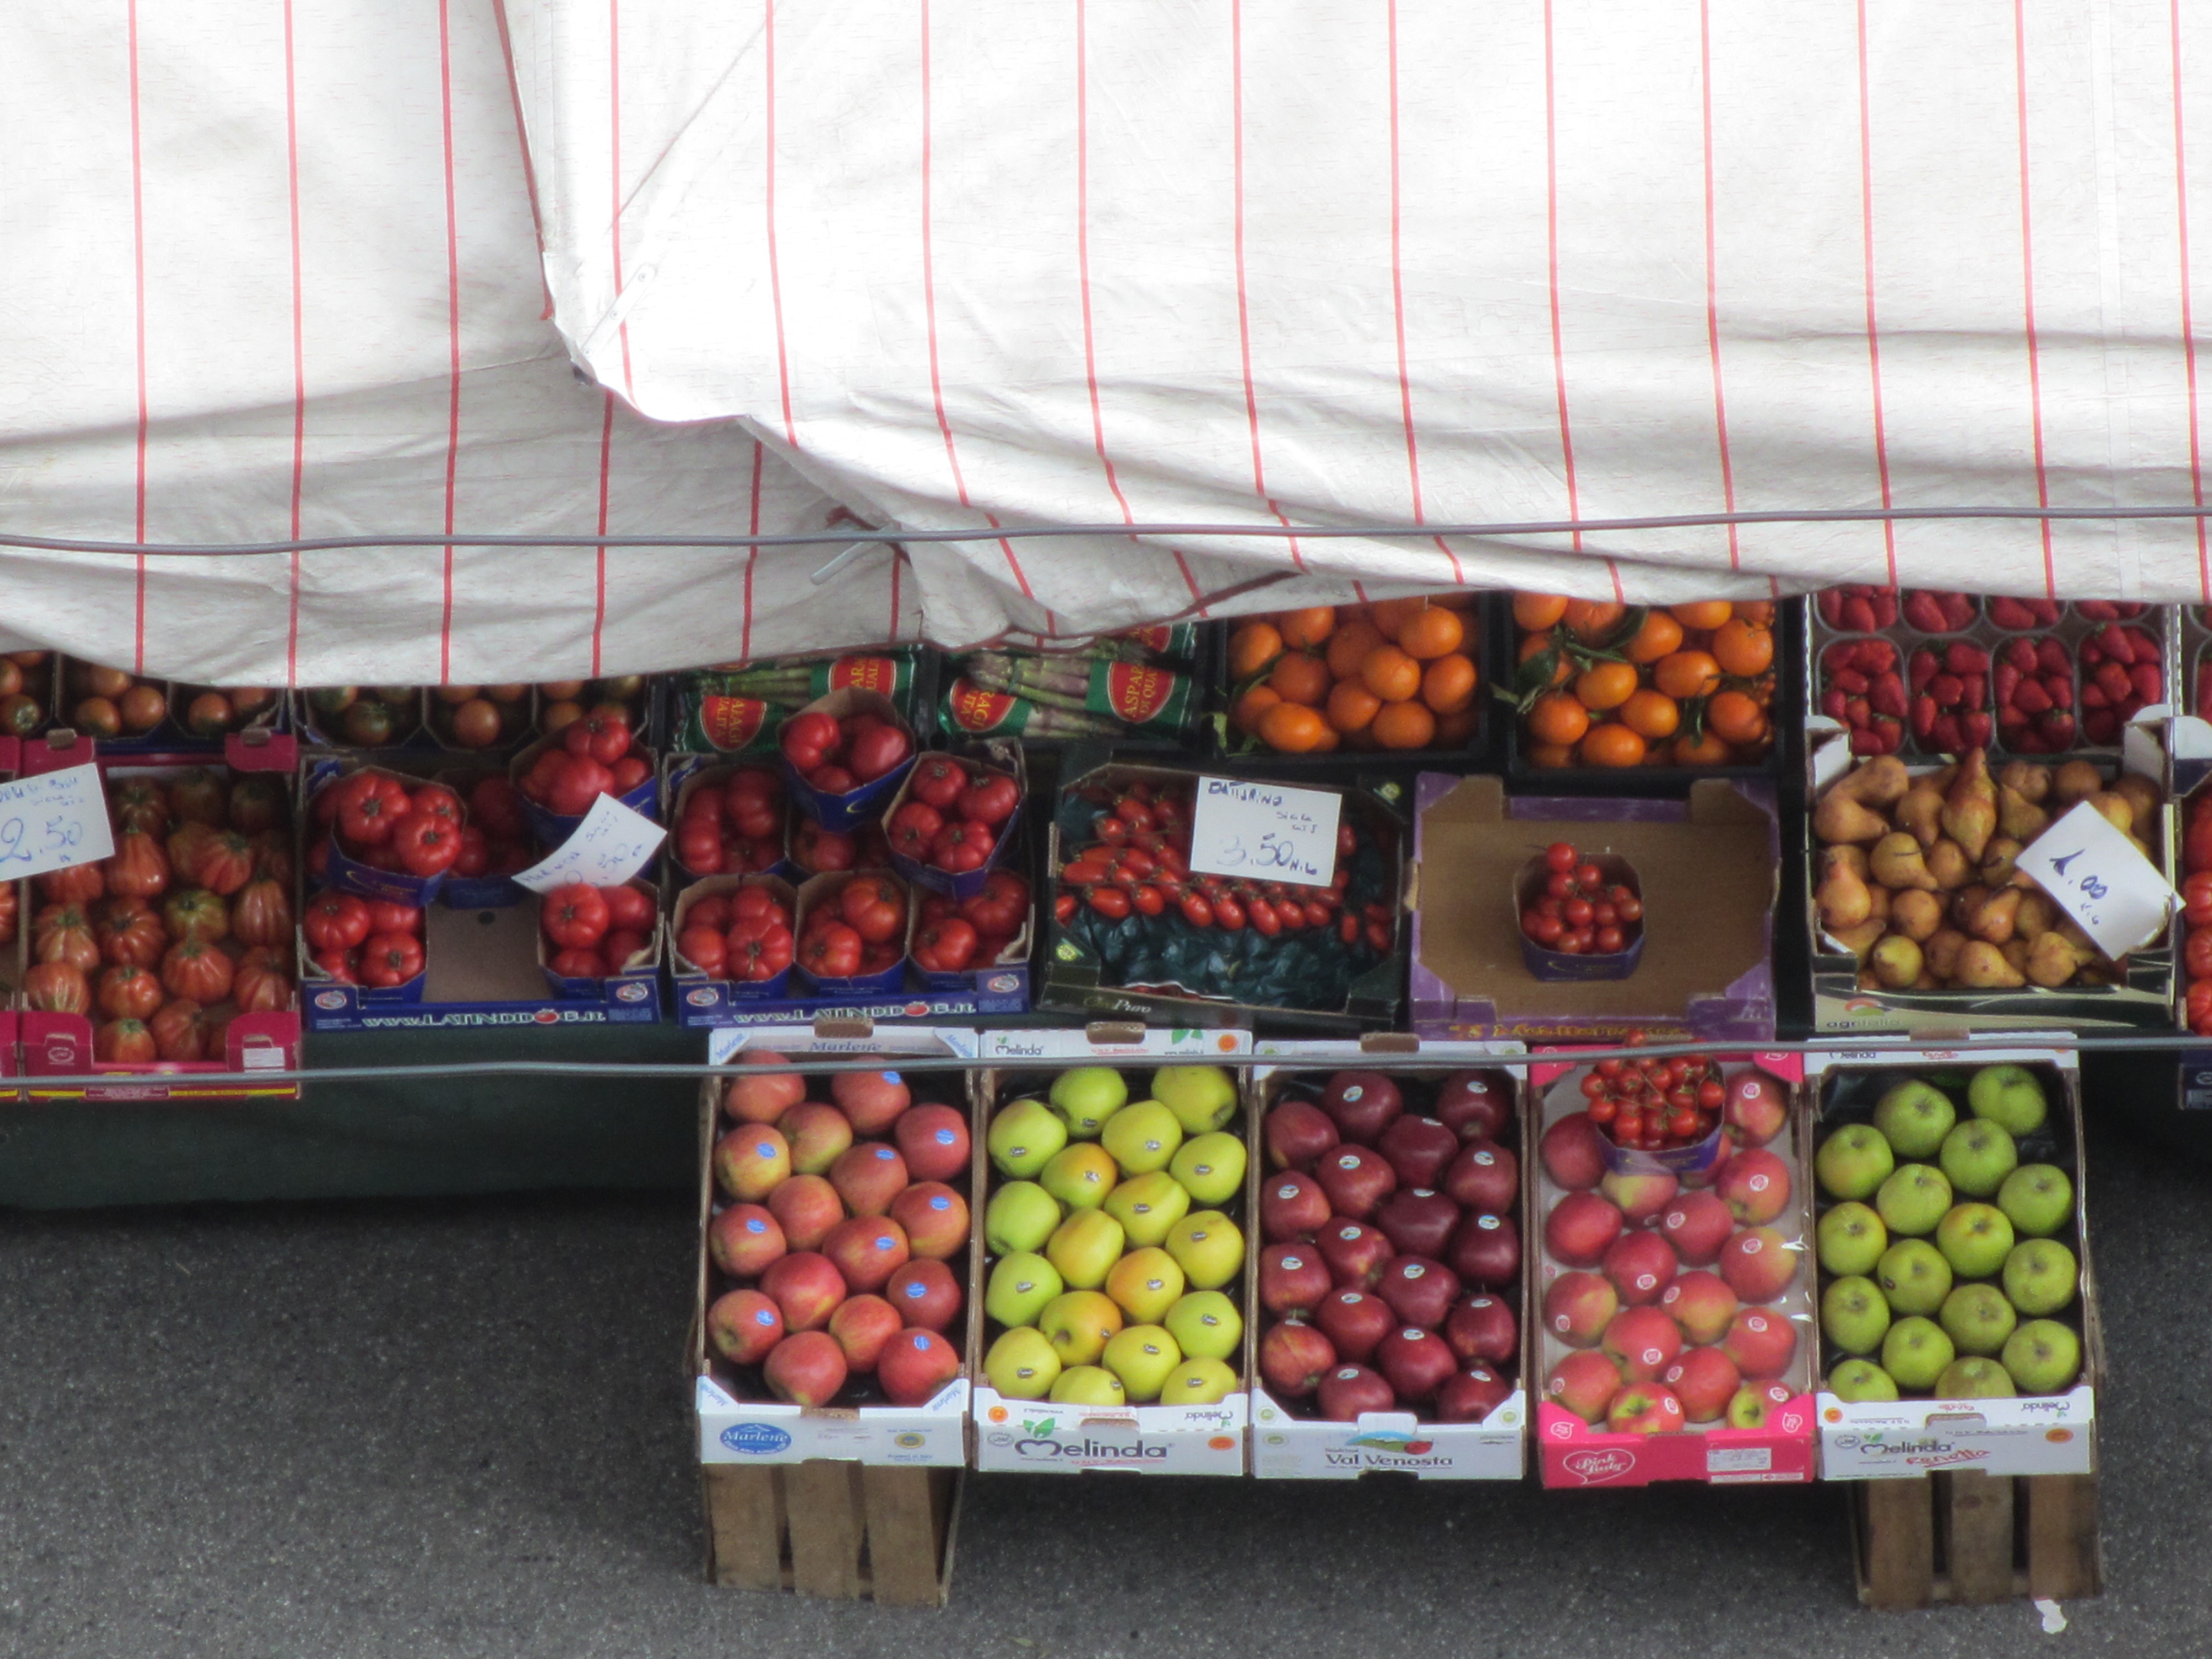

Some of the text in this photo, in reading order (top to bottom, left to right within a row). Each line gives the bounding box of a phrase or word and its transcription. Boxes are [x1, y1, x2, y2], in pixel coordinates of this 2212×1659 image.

[723, 1431, 789, 1443] Marlene
[1015, 1439, 1168, 1458] Melinda
[1860, 1440, 1951, 1455] Melinda
[1325, 1454, 1453, 1465] Val Venosta
